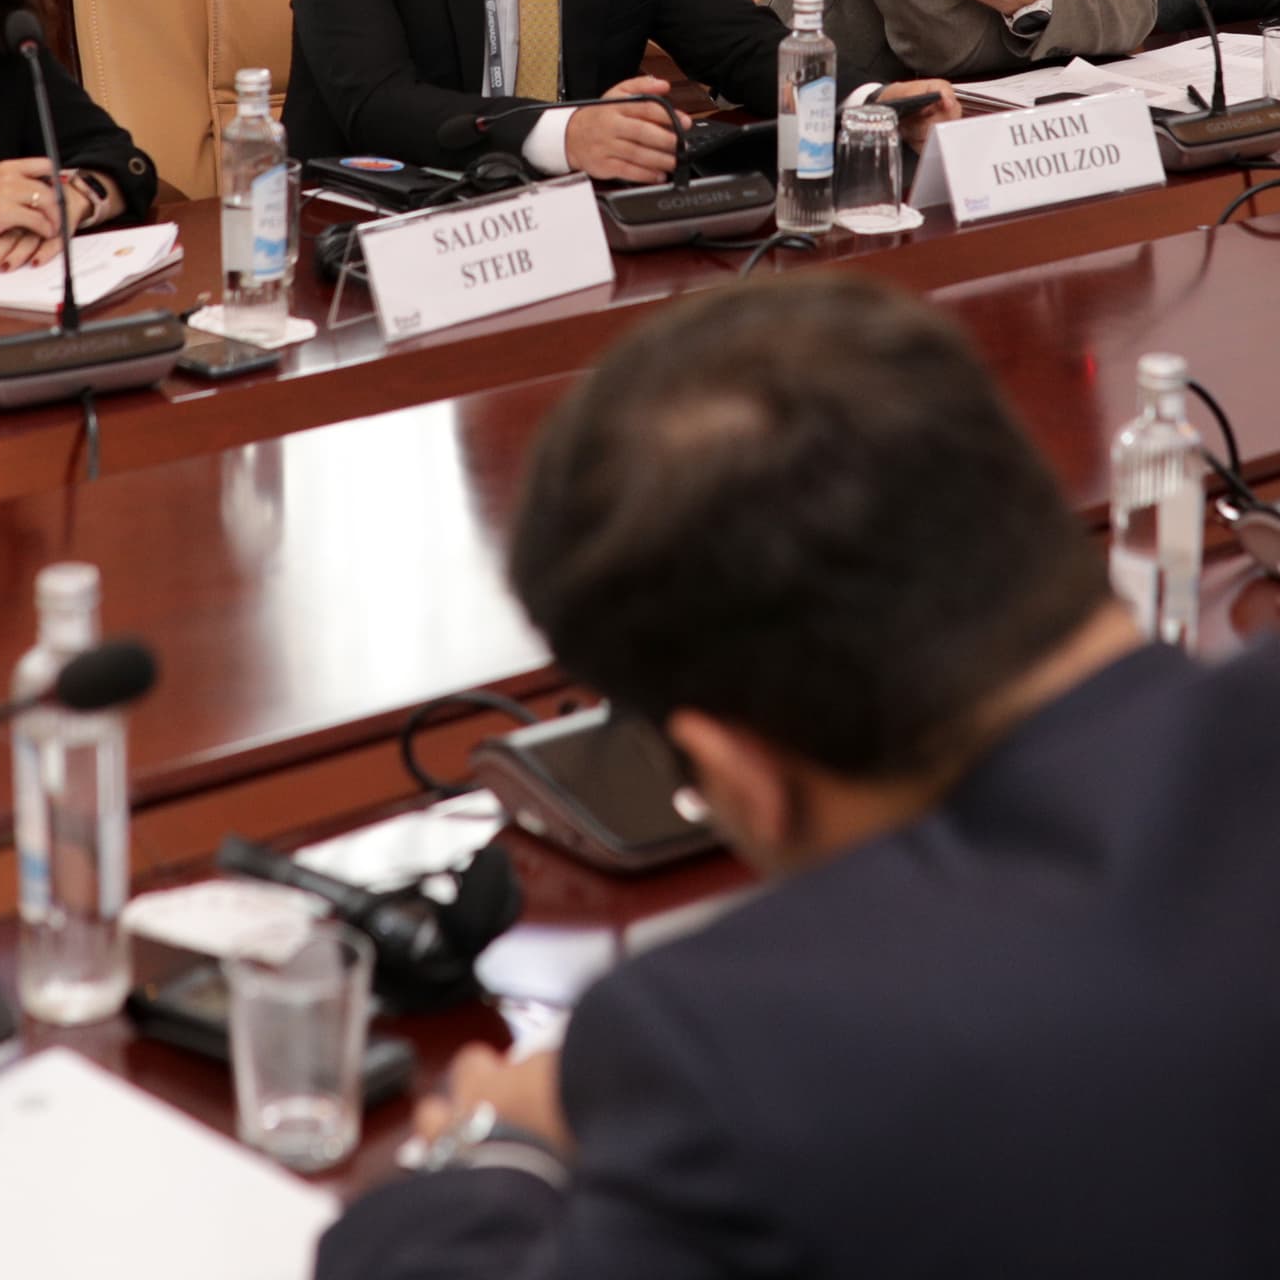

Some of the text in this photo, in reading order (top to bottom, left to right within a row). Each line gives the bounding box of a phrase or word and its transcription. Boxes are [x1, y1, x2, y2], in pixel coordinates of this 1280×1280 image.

[1009, 114, 1088, 147] HAKIM
[992, 144, 1120, 186] ISMOILZOD
[432, 206, 539, 255] SALOME
[461, 249, 533, 289] STEIB
